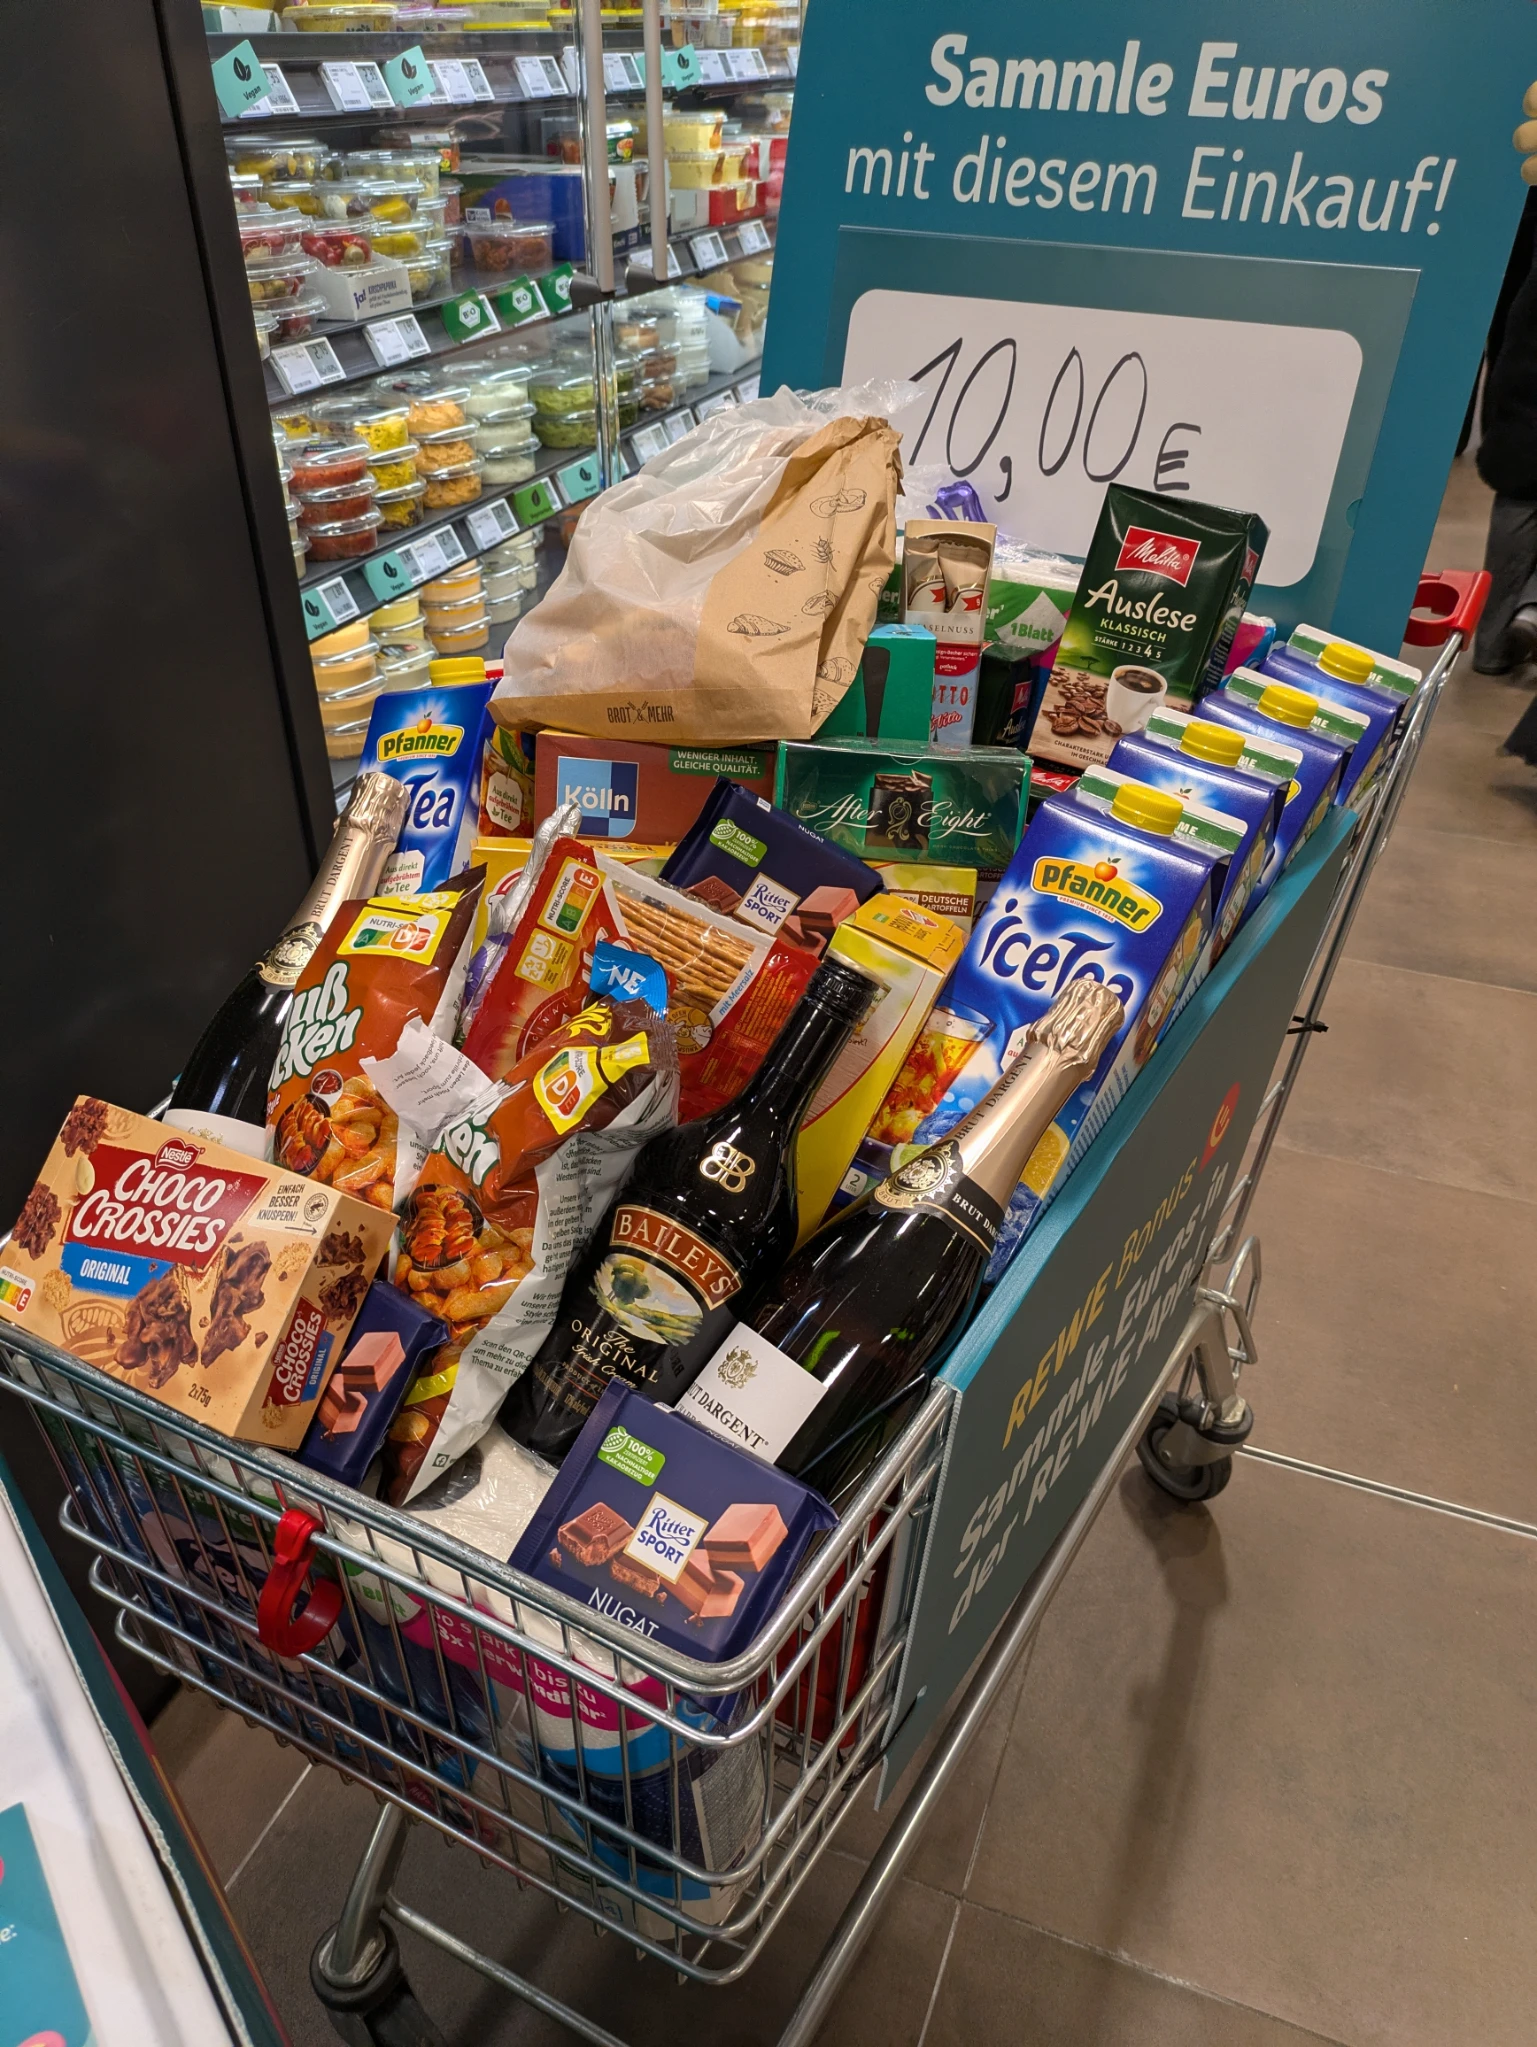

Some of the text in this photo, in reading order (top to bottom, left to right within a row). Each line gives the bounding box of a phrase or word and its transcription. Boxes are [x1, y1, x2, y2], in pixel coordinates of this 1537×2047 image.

[407, 83, 425, 97] Vegan
[925, 33, 1389, 125] Sammle Euros
[243, 85, 262, 101] Vegan
[845, 131, 1457, 237] mit diesem Einkauf!
[353, 289, 367, 311] ja!
[906, 336, 1149, 502] 10,00
[1126, 537, 1182, 571] Melitta
[391, 580, 406, 592] Vegan
[1084, 579, 1197, 632] Auslese
[313, 619, 329, 632] Vegan
[1100, 618, 1167, 643] KLASSISCH
[1094, 635, 1118, 647] STÄRKE
[1128, 644, 1134, 652] 2
[1135, 646, 1142, 654] 3
[1143, 643, 1152, 657] 4
[1155, 650, 1161, 658] 5
[606, 706, 631, 724] BROT
[647, 704, 675, 724] MEHR
[677, 749, 758, 765] WENIGER INHALT.
[1054, 739, 1104, 759] CHARAKTERSTARK
[673, 760, 761, 775] GLEICHE QUALITÄT.
[564, 784, 629, 812] Kölln
[499, 809, 513, 824] Tee
[796, 793, 993, 840] After Eight
[736, 830, 758, 850] 100%
[798, 824, 825, 844] NUGAT
[311, 836, 354, 918] BRUT DARGENT
[398, 861, 418, 872] direkt
[396, 882, 410, 893] Tee
[547, 877, 571, 922] NUTRI-SCORE
[752, 882, 791, 913] Ritter
[1041, 863, 1150, 925] Pfanner
[744, 898, 782, 925] SPORT
[921, 894, 969, 907] DEUTSCHE
[1059, 895, 1085, 909] PREMIUM
[1085, 904, 1102, 916] SINCE
[719, 968, 755, 1016] mit Meersalz
[953, 1053, 1033, 1141] BRUT DARGENT
[161, 1146, 194, 1164] Nestlé
[113, 1158, 226, 1211] CHOCO
[277, 1183, 305, 1195] EINFACH
[849, 1174, 861, 1187] 2
[268, 1195, 301, 1209] BESSER
[877, 1188, 901, 1205] BRUT
[952, 1192, 984, 1223] BRUT
[72, 1188, 226, 1253] CROSSIES
[256, 1208, 299, 1222] KNUSPERN!
[542, 1241, 552, 1251] Da
[618, 1213, 731, 1295] BAILEYS
[1, 1269, 28, 1287] NUTRI-SCORE
[80, 1258, 132, 1286] ORIGINAL
[520, 1301, 546, 1310] unsere
[532, 1292, 546, 1301] Wir
[1002, 1262, 1114, 1452] REWE
[1114, 1156, 1198, 1290] Bonus
[525, 1310, 543, 1319] Style
[275, 1318, 306, 1384] CHOCO
[481, 1339, 513, 1354] Scan den
[571, 1319, 660, 1385] ORIGINAL
[603, 1329, 636, 1354] The
[283, 1311, 323, 1403] CROSSIES
[309, 1348, 328, 1386] ORIGINAL
[471, 1355, 503, 1372] Thema zu
[474, 1347, 514, 1366] um mehr zu
[571, 1344, 638, 1390] Irish Cream
[953, 1162, 1229, 1579] Sammle Euros in
[188, 1383, 212, 1409] 2x75g
[697, 1391, 757, 1450] DARGENT
[627, 1440, 654, 1462] 100%
[705, 1429, 740, 1450] NUGAT
[605, 1454, 643, 1481] KAKAOBEZUG
[615, 1451, 656, 1480] NACHHALTIGER
[623, 1449, 649, 1466] ZERTIFIZIERT
[948, 1511, 1020, 1636] der
[1023, 1331, 1137, 1527] REWE
[645, 1507, 697, 1547] Ritter
[636, 1530, 684, 1566] SPORT
[588, 1587, 660, 1638] NUGAT
[533, 1661, 568, 1688] bis
